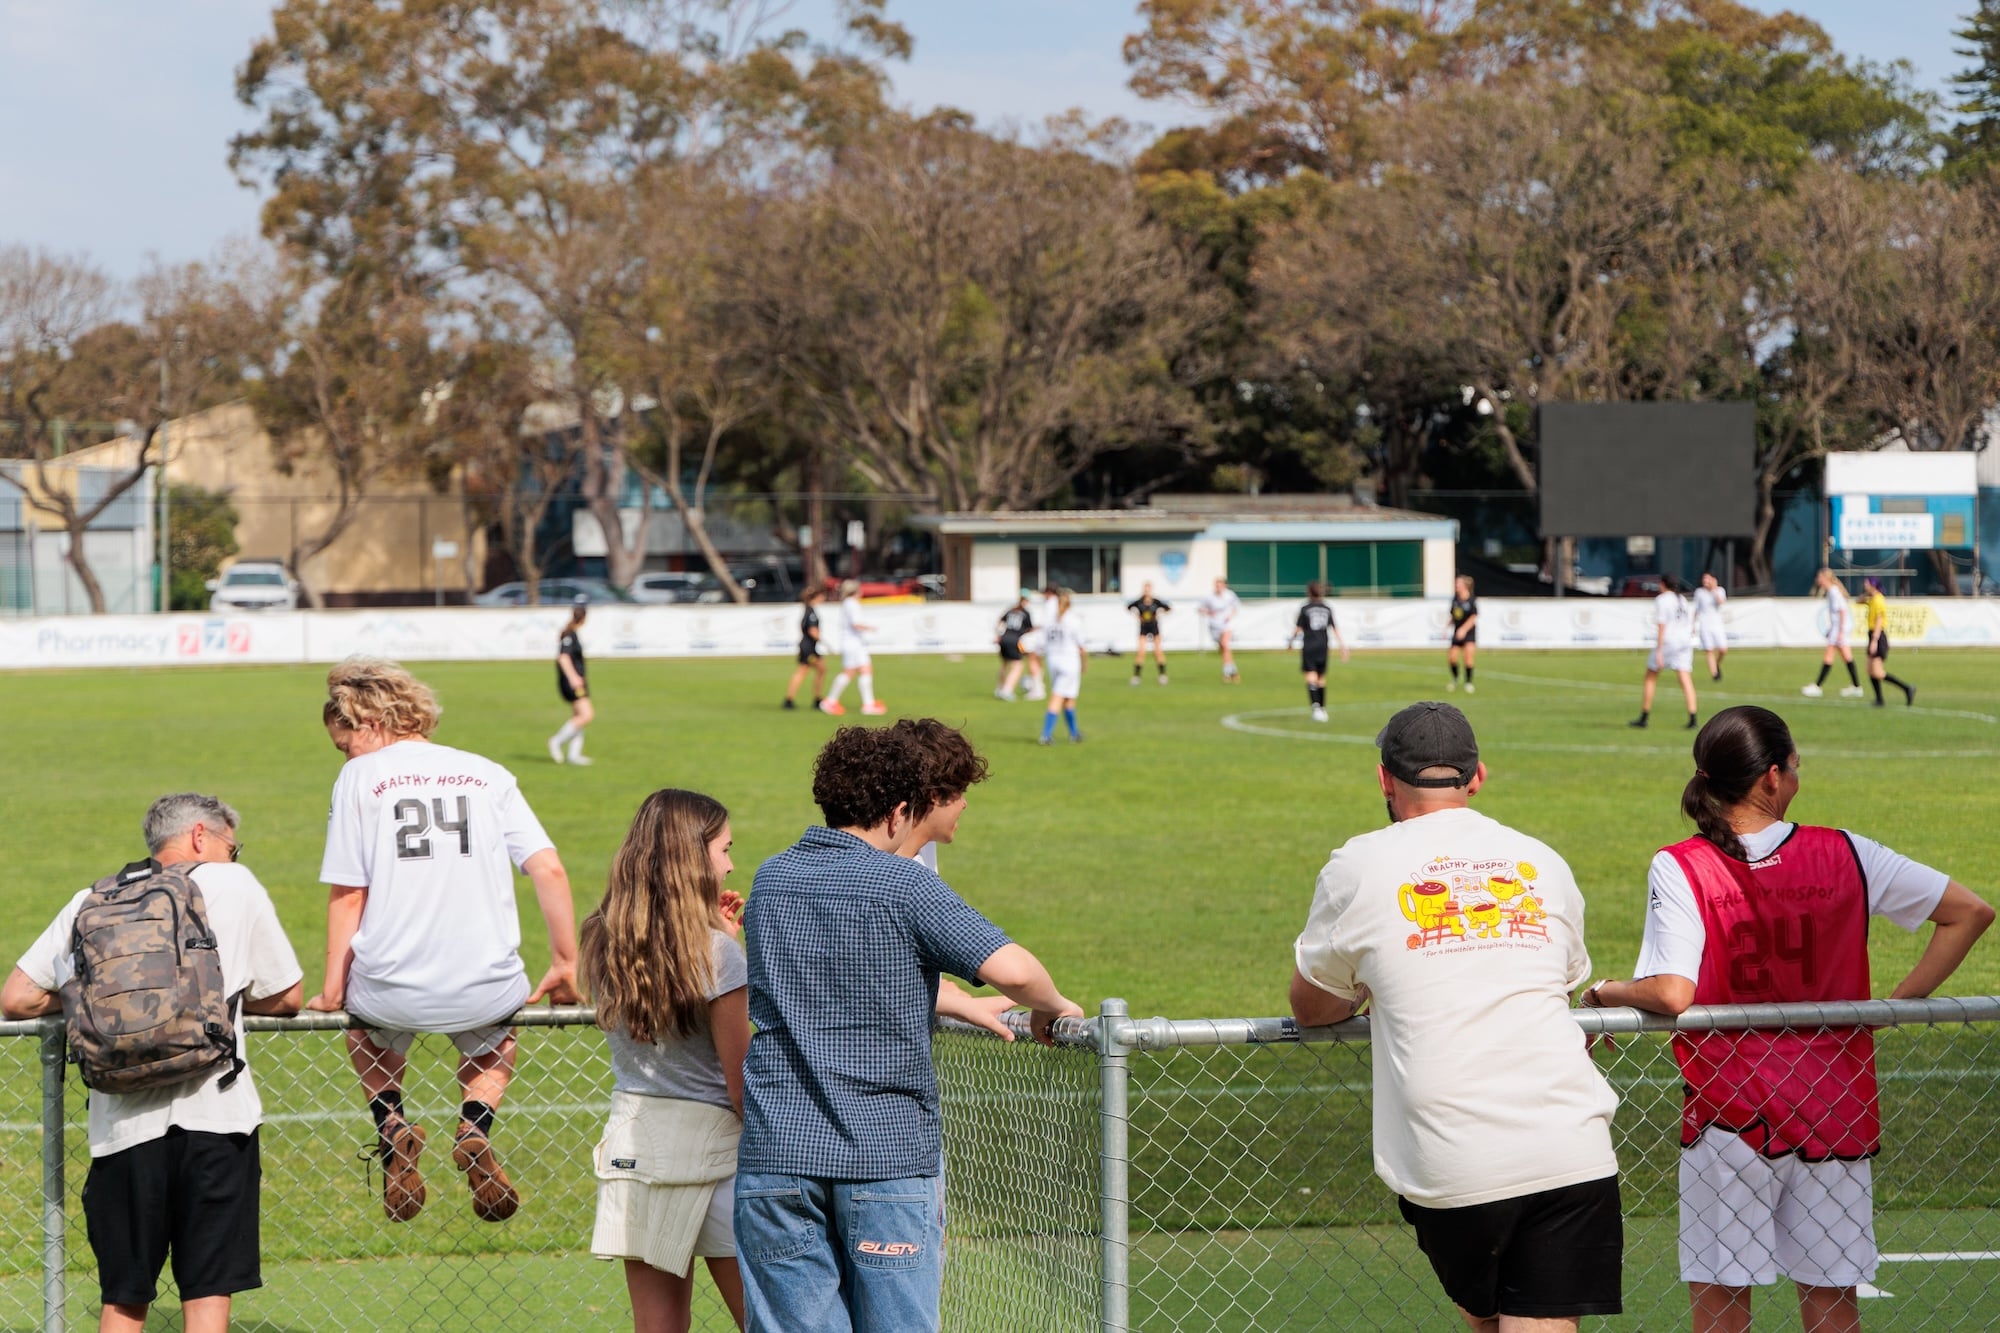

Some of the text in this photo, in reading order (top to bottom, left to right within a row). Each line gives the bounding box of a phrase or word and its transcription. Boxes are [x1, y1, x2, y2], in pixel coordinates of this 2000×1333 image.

[38, 627, 170, 656] Pharmacy
[372, 774, 489, 798] HEALTHY HOSPO!
[393, 795, 472, 861] 24
[1428, 861, 1507, 873] HEALTHY HOSPO!
[1706, 885, 1834, 911] EALY HOSPO!
[1729, 912, 1816, 995] 24
[857, 1240, 920, 1256] RUSTY
